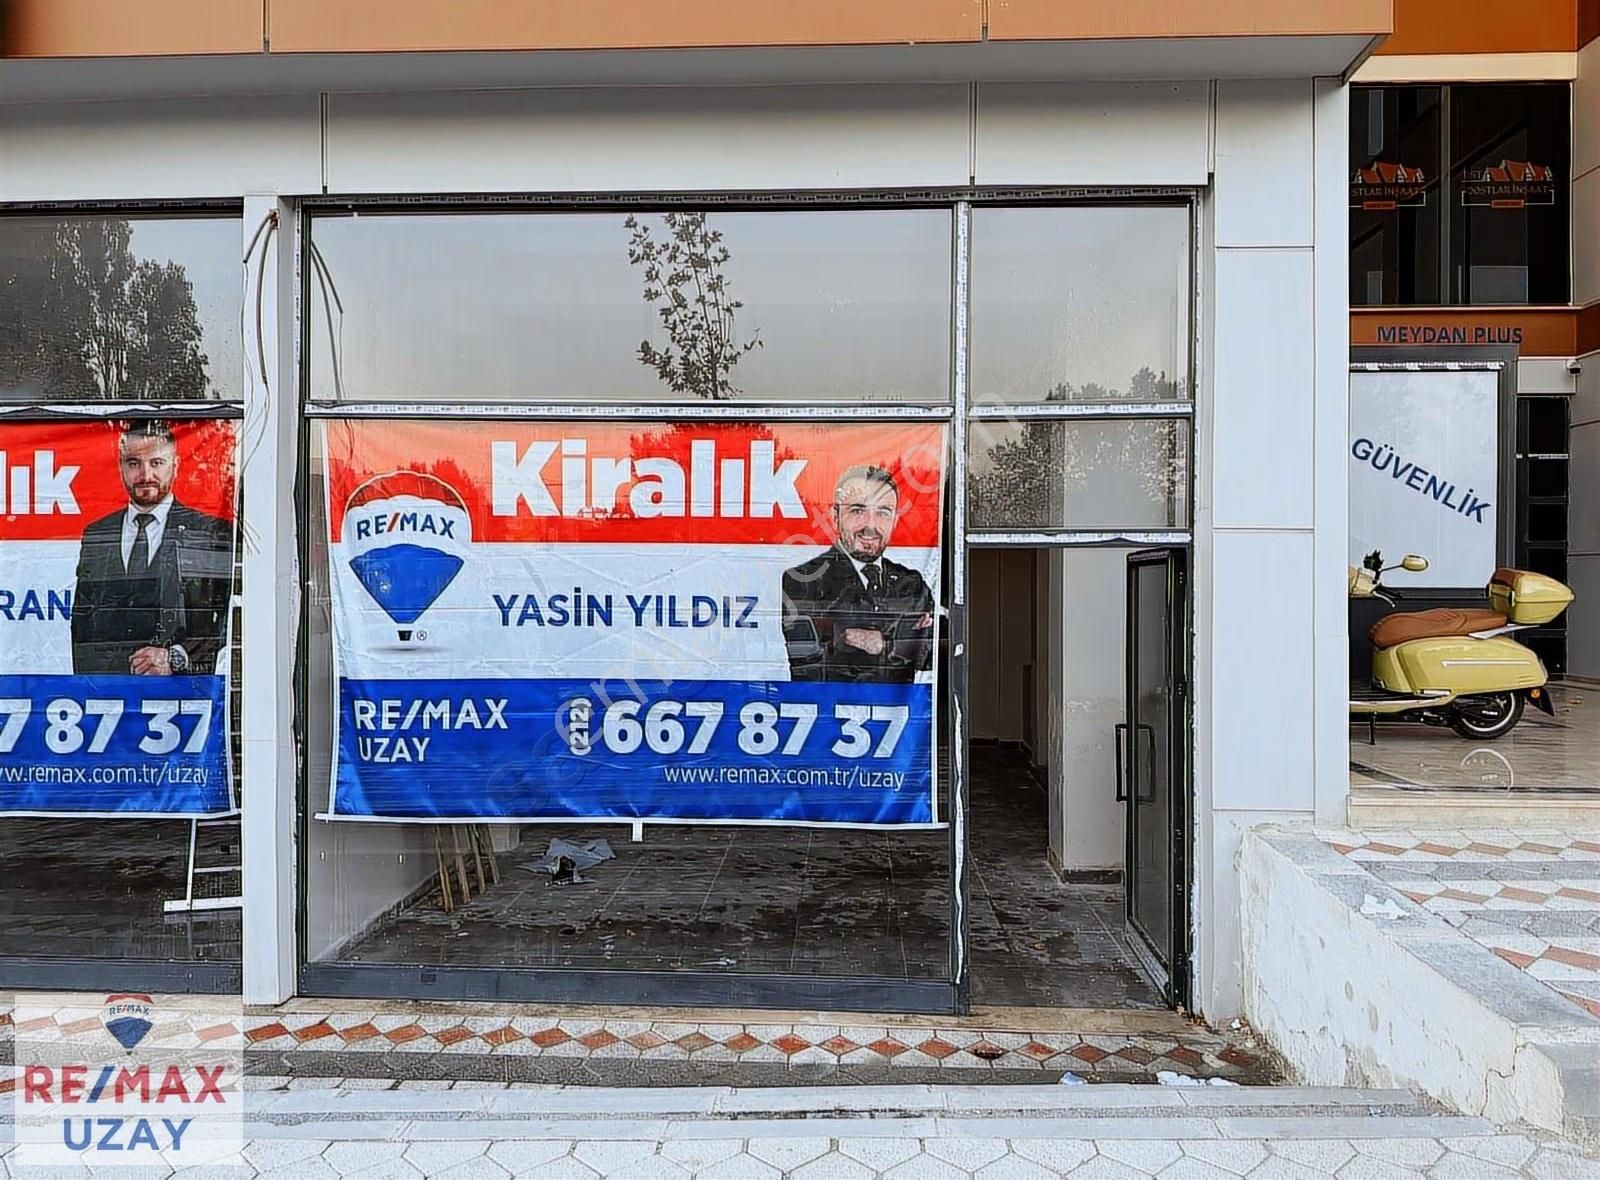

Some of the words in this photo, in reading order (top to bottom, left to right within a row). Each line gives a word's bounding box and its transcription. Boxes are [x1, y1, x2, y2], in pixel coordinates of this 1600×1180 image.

[1377, 325, 1467, 344] MEYDAN
[1473, 326, 1523, 344] PLUS
[491, 438, 809, 520] Kiralık
[1351, 437, 1492, 524] GÜVENLİK
[356, 511, 455, 542] RE/MAX
[0, 588, 72, 621] RAN
[492, 586, 613, 628] YASİN
[625, 594, 760, 628] YILDIZ
[45, 699, 124, 754] 87
[138, 699, 213, 754] 37
[354, 698, 508, 730] RE/MAX
[569, 697, 593, 756] (212)
[602, 700, 724, 754] 667
[737, 702, 818, 755] 87
[831, 704, 910, 759] 37
[357, 736, 431, 763] UZAY
[0, 761, 210, 787] w.remax.com.tr/uzay
[663, 765, 906, 791] www.remax.com.tr/uzay
